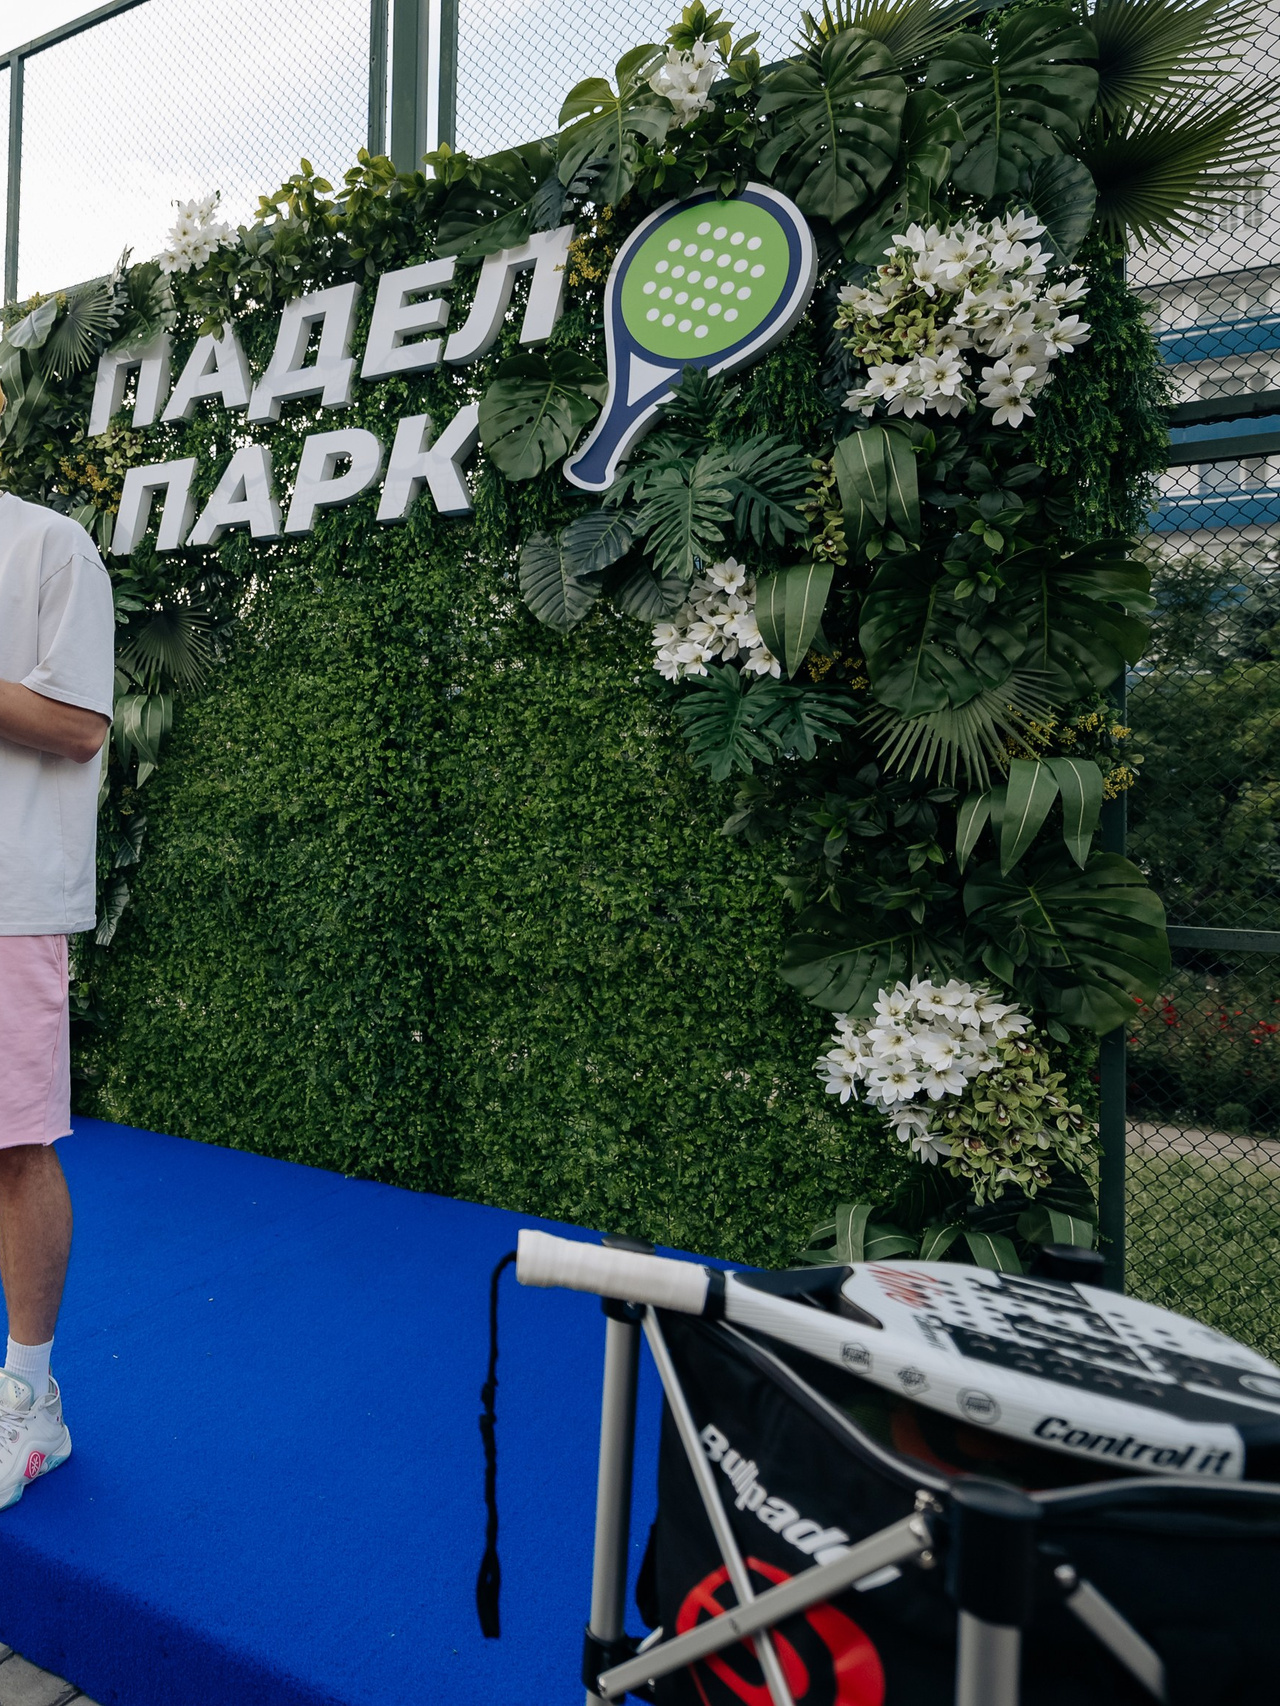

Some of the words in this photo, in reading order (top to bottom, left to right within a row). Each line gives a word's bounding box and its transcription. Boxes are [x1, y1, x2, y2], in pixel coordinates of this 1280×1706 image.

[87, 224, 576, 437] ПАДЕЛ
[111, 403, 481, 556] ПАРК
[1033, 1416, 1196, 1469] Control
